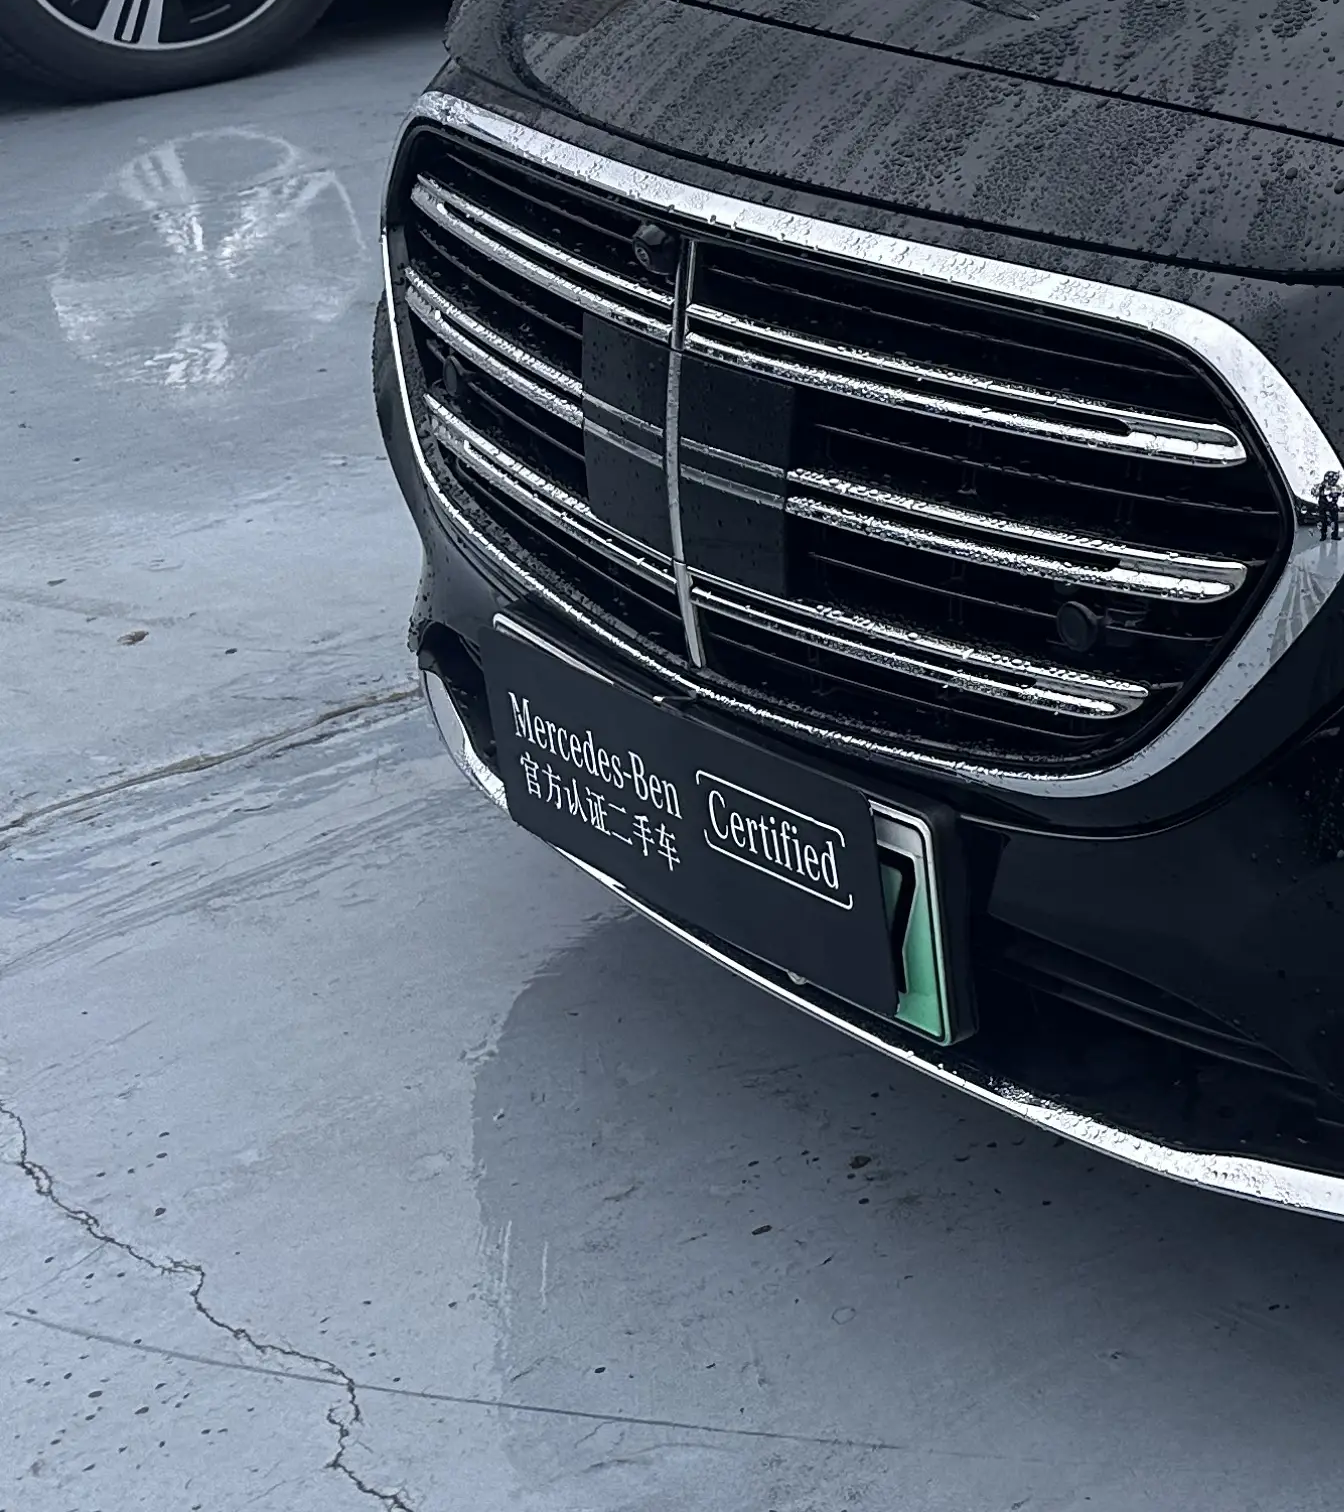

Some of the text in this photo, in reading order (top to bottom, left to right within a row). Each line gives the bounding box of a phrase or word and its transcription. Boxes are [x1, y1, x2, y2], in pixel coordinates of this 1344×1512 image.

[507, 691, 683, 821] Mercedes-Ben
[519, 751, 682, 872] 官方认证二手车
[708, 790, 840, 891] Certified
